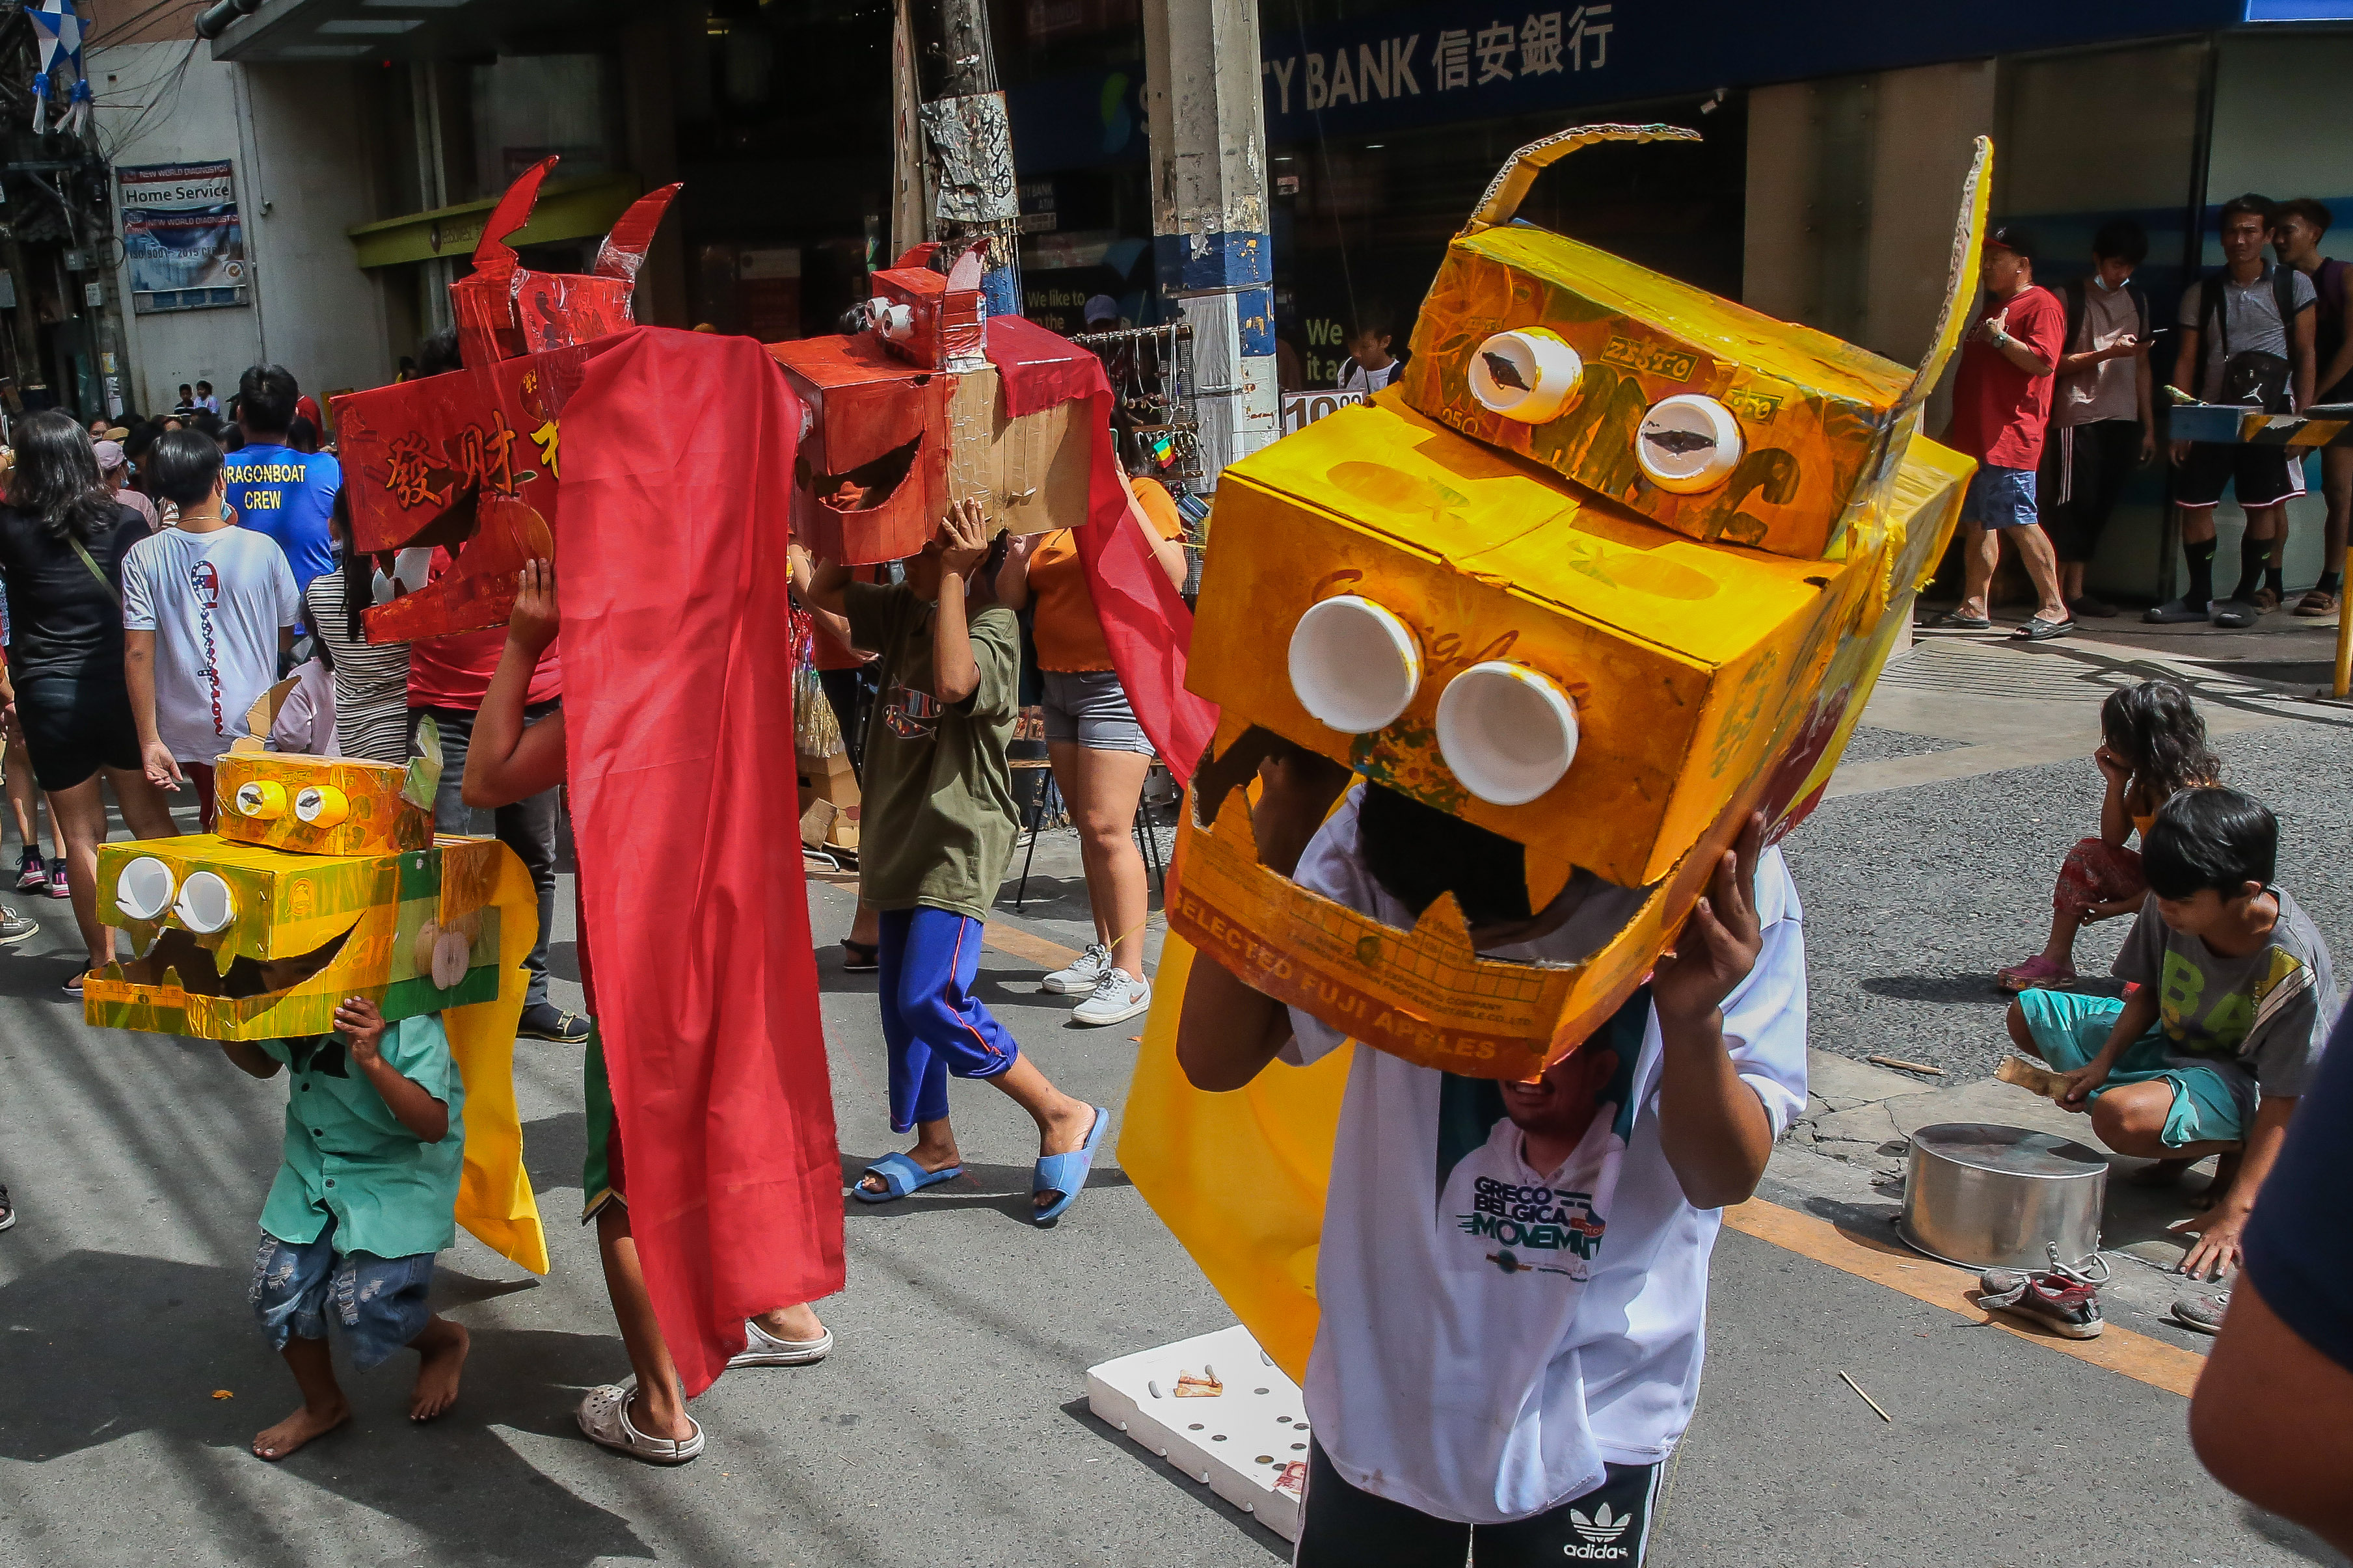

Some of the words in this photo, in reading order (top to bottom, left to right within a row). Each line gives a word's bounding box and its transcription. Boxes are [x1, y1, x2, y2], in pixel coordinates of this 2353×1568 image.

[1306, 34, 1421, 111] BANK
[1431, 4, 1614, 92] 信安銀行
[158, 168, 183, 177] WORLD
[184, 164, 228, 176] DIAGNOSTICS
[126, 189, 173, 204] Home
[176, 184, 230, 200] Service
[167, 217, 194, 226] WORLD
[1028, 291, 1047, 308] We
[1049, 288, 1070, 307] like
[1073, 290, 1086, 306] to
[1045, 312, 1065, 330] the
[1306, 318, 1343, 346] We
[1306, 351, 1321, 381] it
[224, 464, 306, 484] RAGONBOAT
[245, 490, 282, 510] CREW
[1300, 973, 1364, 1020] FUJI
[1373, 1012, 1496, 1061] APPLES
[1473, 1175, 1553, 1204] GRECO
[1473, 1192, 1570, 1227] BELGICA
[1563, 1543, 1628, 1560] adidas
